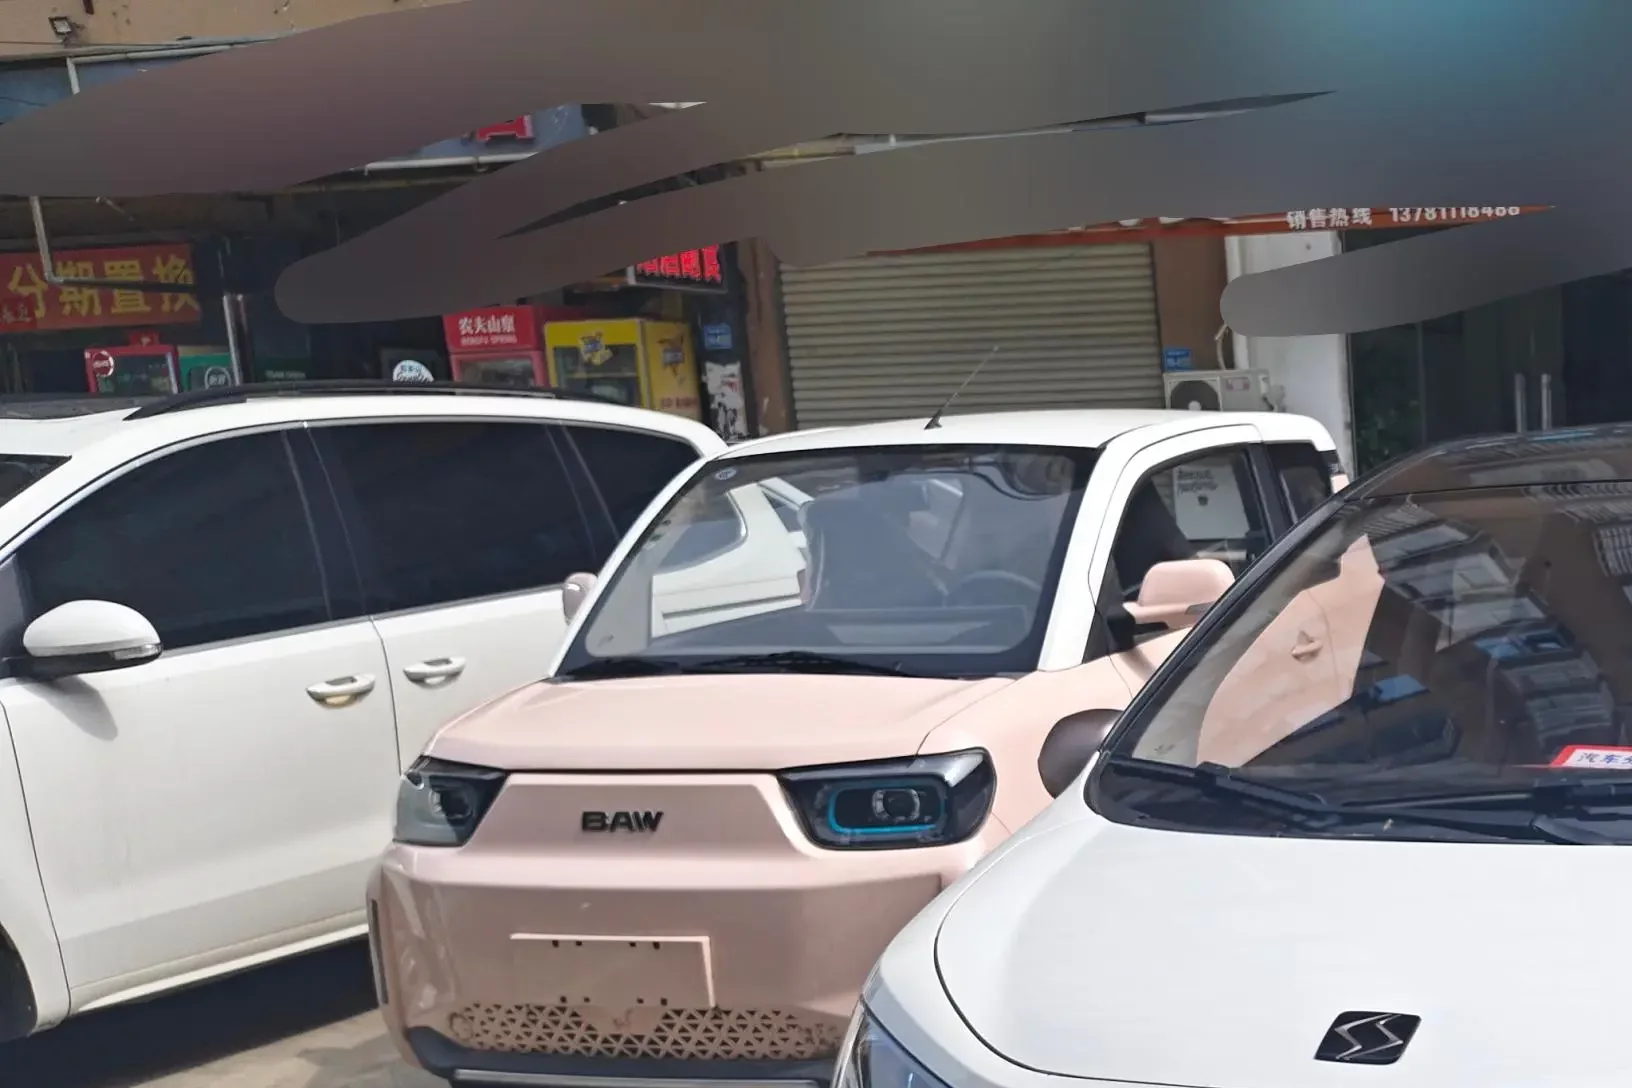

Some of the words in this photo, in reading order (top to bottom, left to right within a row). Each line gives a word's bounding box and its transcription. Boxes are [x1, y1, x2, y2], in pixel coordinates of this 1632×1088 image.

[459, 314, 515, 335] 农夫山泉
[582, 810, 664, 833] BAW
